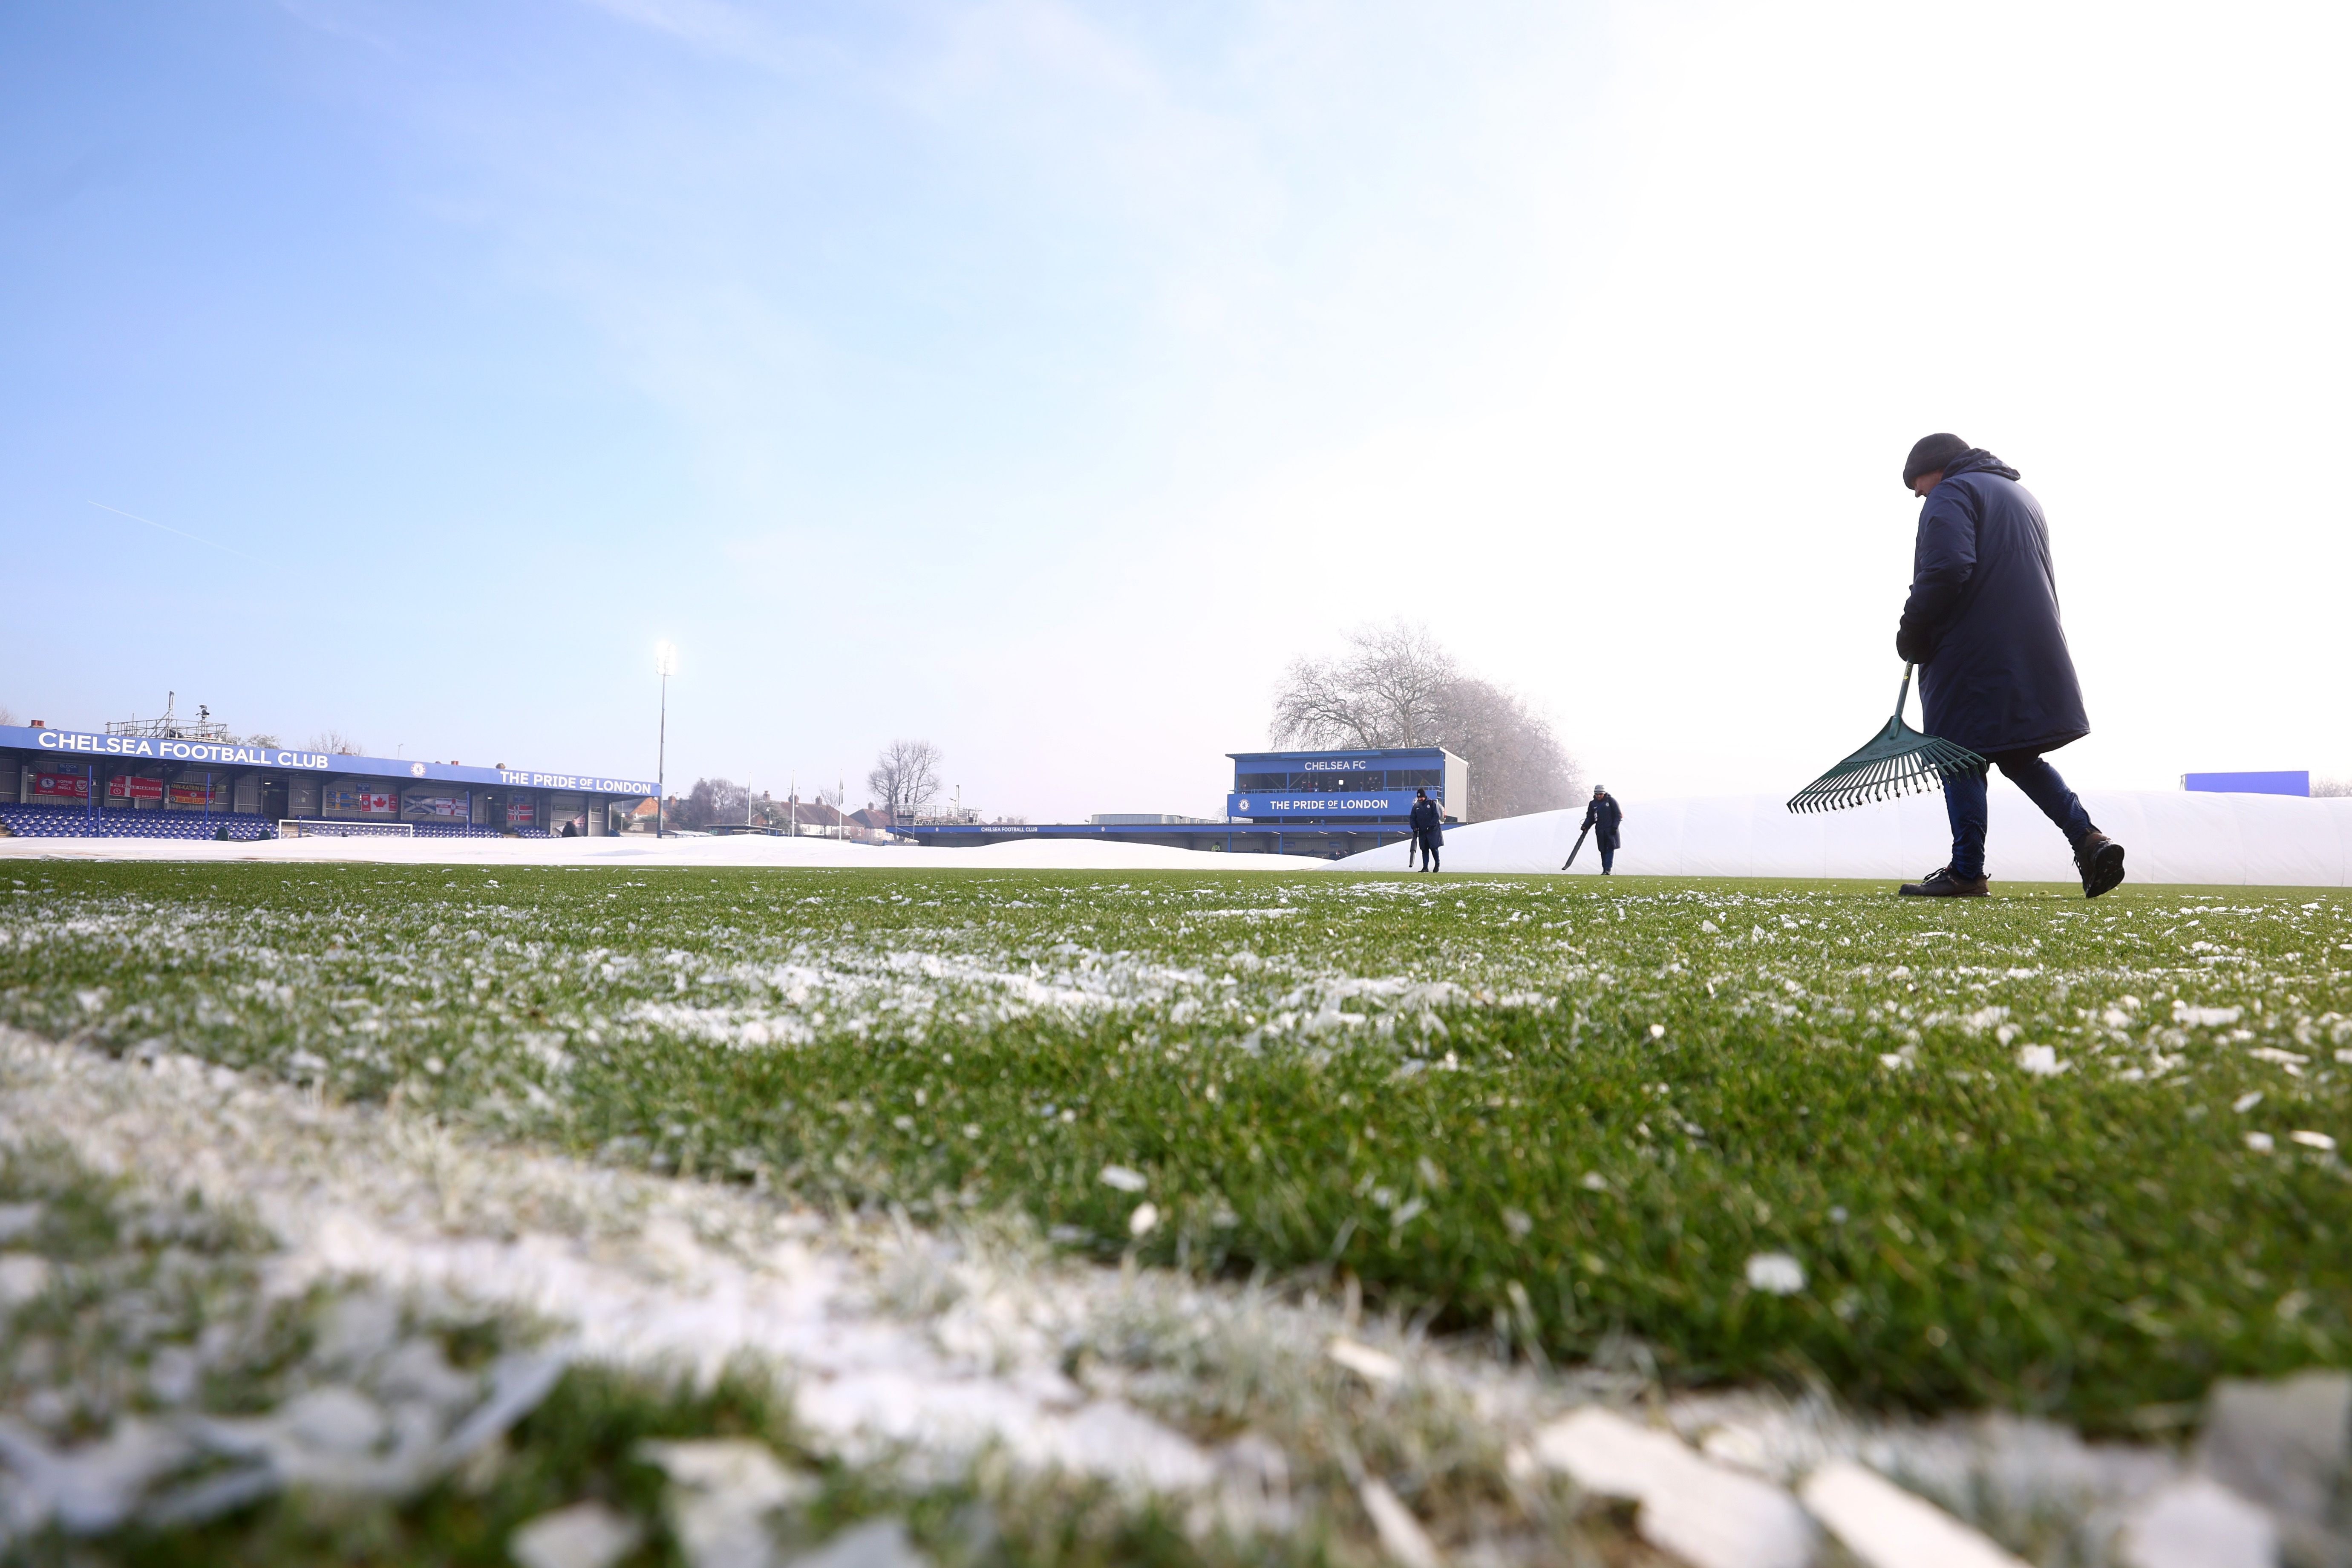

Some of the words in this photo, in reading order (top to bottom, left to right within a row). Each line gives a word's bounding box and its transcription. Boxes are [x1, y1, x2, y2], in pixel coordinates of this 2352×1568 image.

[38, 732, 153, 755] CHELSEA
[160, 742, 272, 764] FOOTBALL
[277, 752, 328, 769] CLUB
[1305, 761, 1350, 770] CHELSEA
[1353, 761, 1366, 769] FC
[171, 783, 199, 791] ANN-KATRIN
[499, 771, 529, 785] THE
[533, 774, 577, 789] PRIDE
[579, 778, 594, 787] OF
[596, 779, 651, 795] LONDON
[1270, 801, 1290, 810] THE
[1293, 801, 1325, 809] PRIDE
[1341, 799, 1388, 809] LONDON
